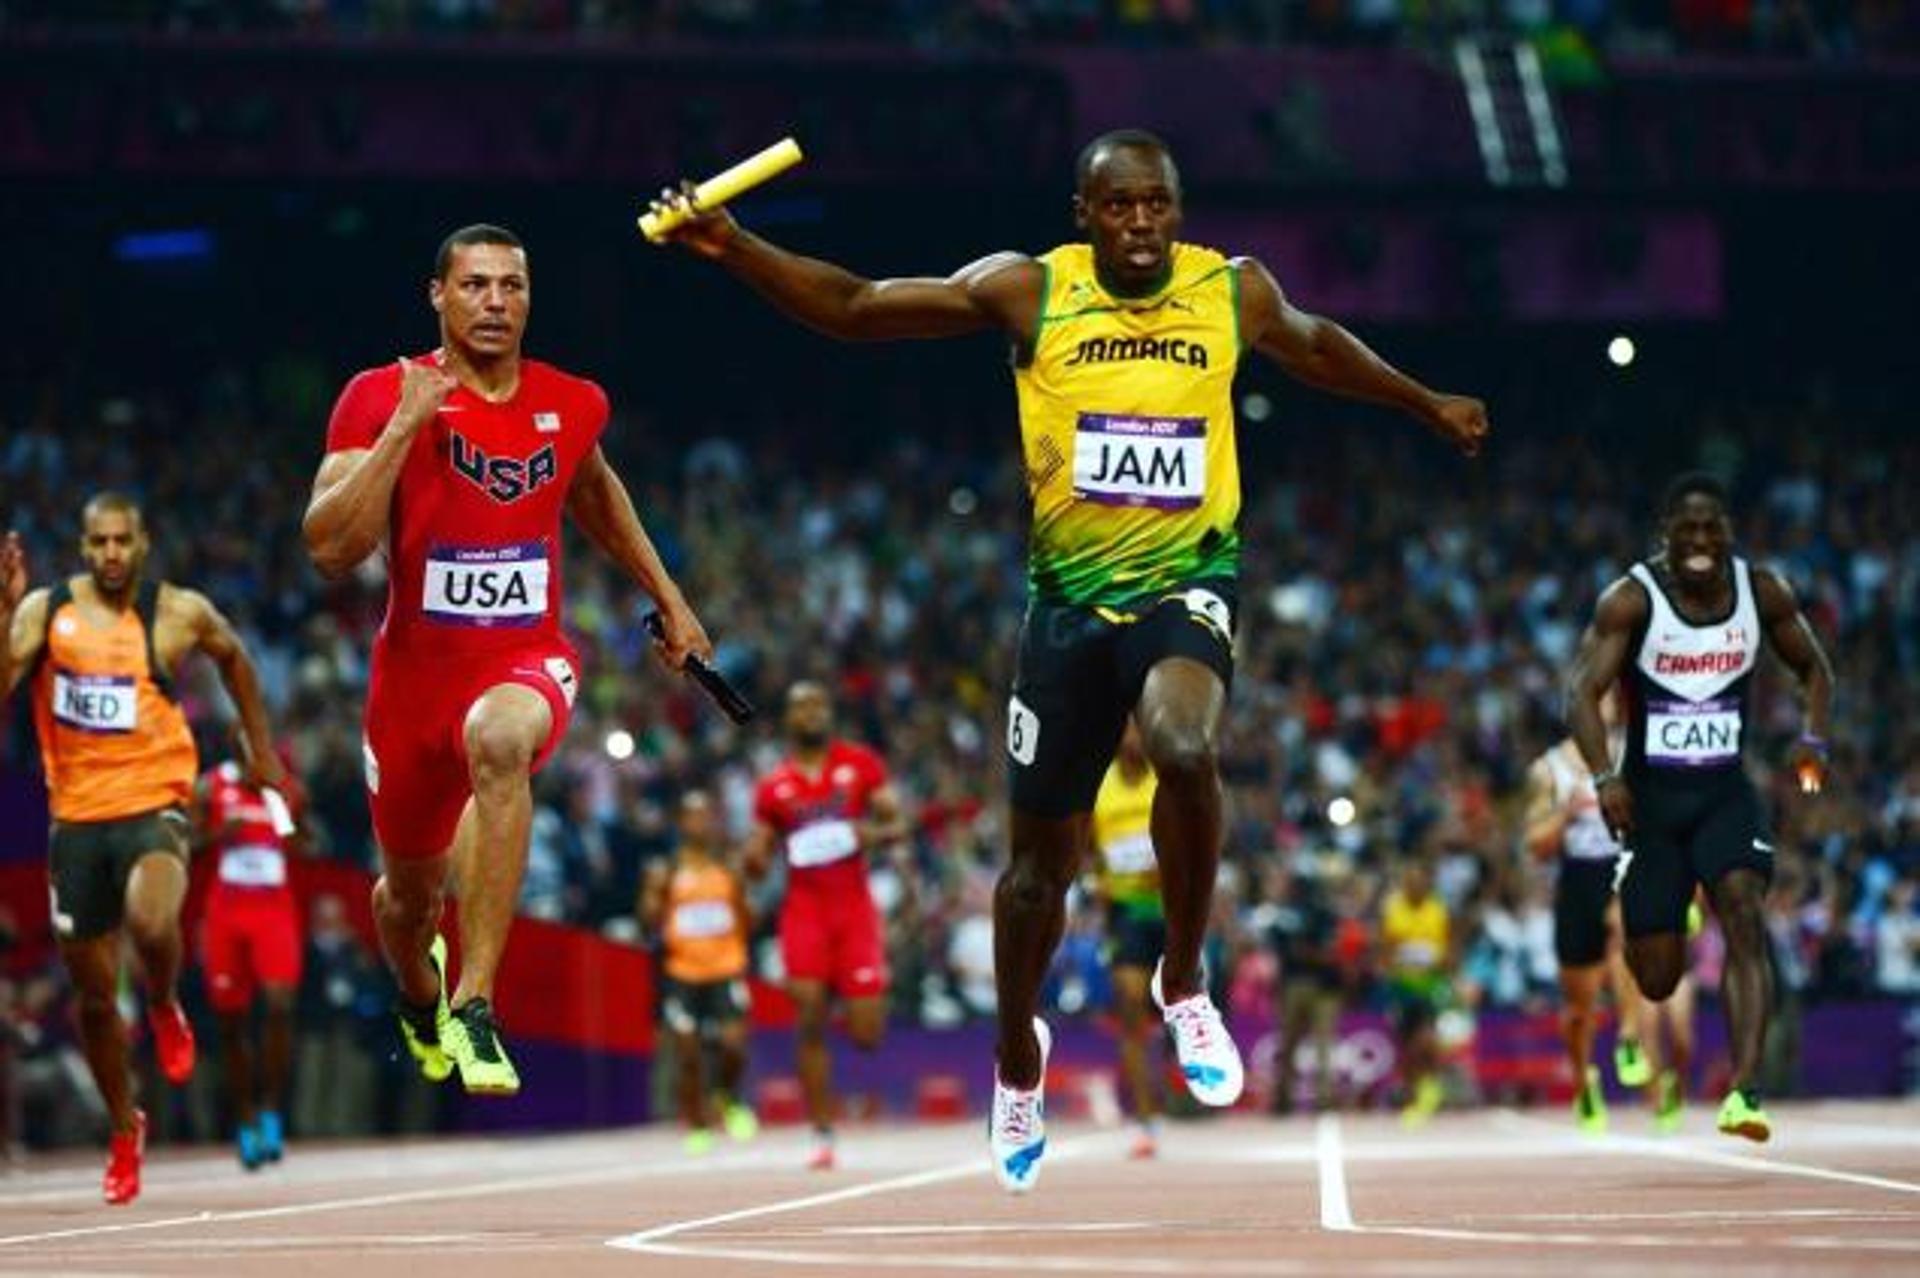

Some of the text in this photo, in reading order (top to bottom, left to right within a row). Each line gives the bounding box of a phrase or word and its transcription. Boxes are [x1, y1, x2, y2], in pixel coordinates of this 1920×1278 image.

[1064, 338, 1208, 370] JAMAICA
[451, 430, 556, 504] USA
[1091, 444, 1187, 487] JAM
[444, 569, 530, 608] USA
[1655, 650, 1746, 674] CANADA
[64, 688, 120, 721] NED
[1013, 711, 1023, 753] 6
[1660, 720, 1732, 751] CAN
